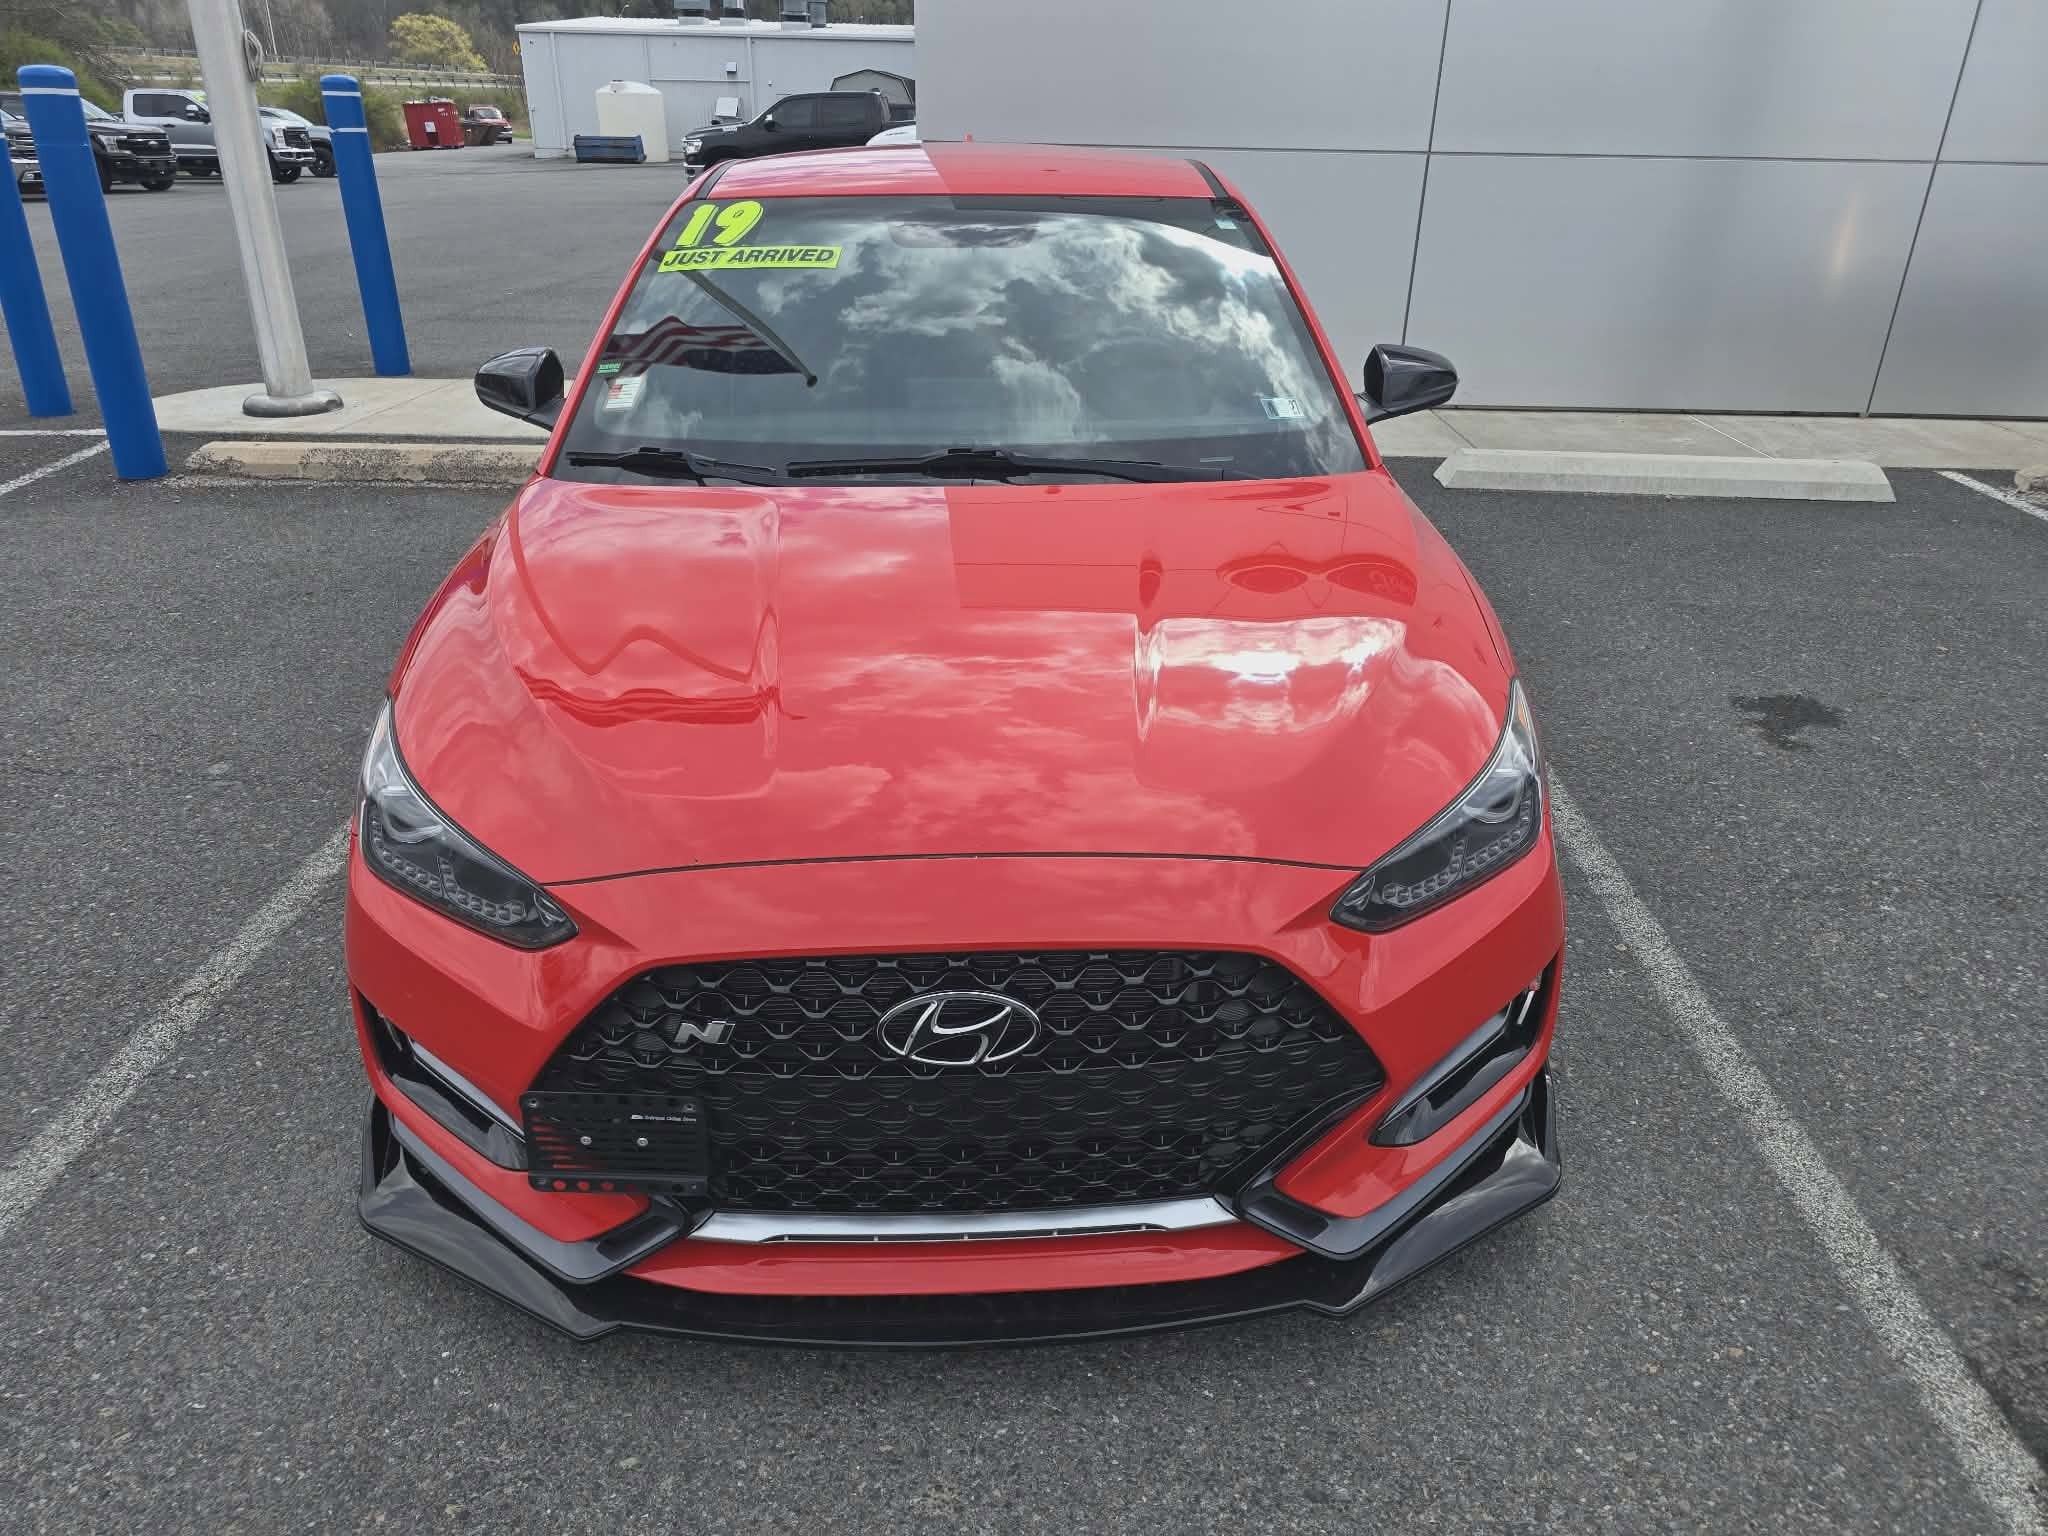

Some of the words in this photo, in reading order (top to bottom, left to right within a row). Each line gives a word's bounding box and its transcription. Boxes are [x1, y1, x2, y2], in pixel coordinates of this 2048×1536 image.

[675, 200, 764, 247] 19
[663, 250, 726, 267] JUST
[728, 248, 834, 263] ARRIVED
[673, 1020, 736, 1045] N
